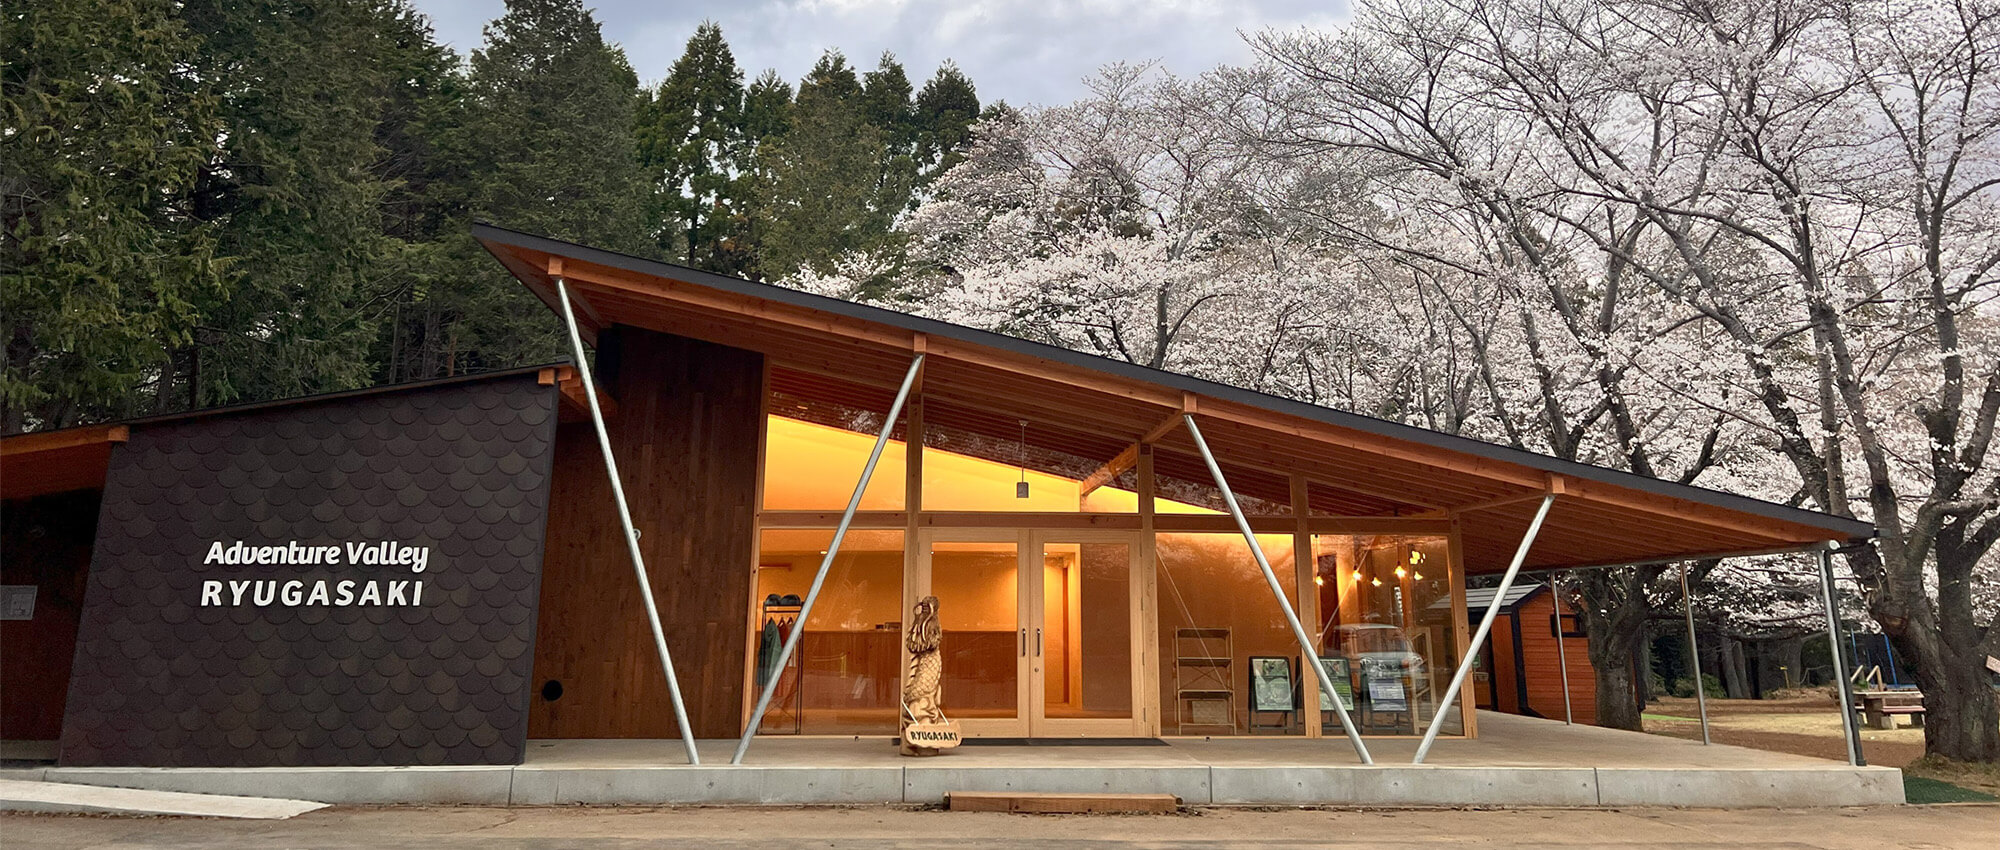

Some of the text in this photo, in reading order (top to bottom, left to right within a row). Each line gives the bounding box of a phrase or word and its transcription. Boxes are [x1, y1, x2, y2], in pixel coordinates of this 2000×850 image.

[203, 541, 429, 573] Adventure Valley
[200, 580, 423, 607] RYUGASAKI
[910, 731, 958, 741] RYUGASAKI
